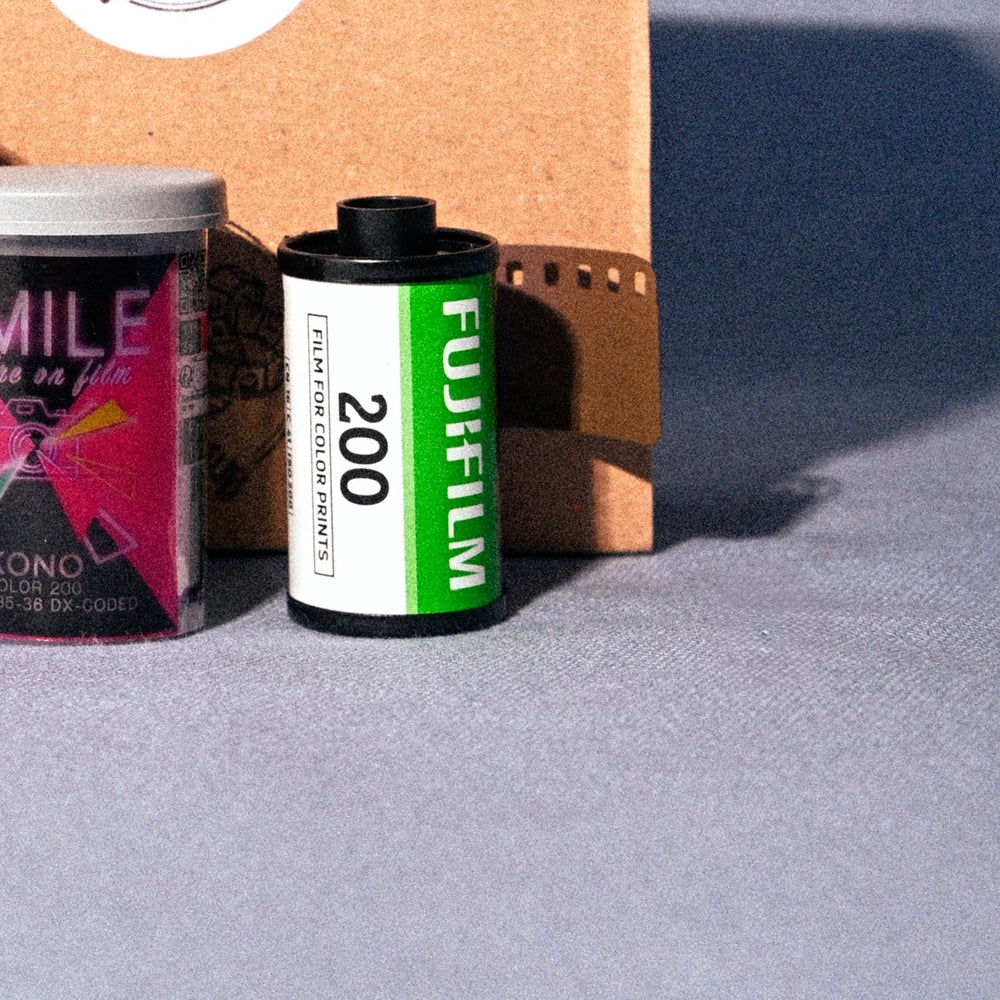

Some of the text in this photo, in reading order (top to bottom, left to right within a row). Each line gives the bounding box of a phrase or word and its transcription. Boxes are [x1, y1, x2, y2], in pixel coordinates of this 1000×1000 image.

[33, 365, 66, 386] on
[72, 358, 132, 397] film
[312, 328, 329, 561] FILM FOR COLOR PRINTS
[338, 392, 389, 506] 200
[441, 297, 486, 591] FUJIFILM
[50, 581, 83, 596] 200
[50, 597, 138, 613] DX-CODED
